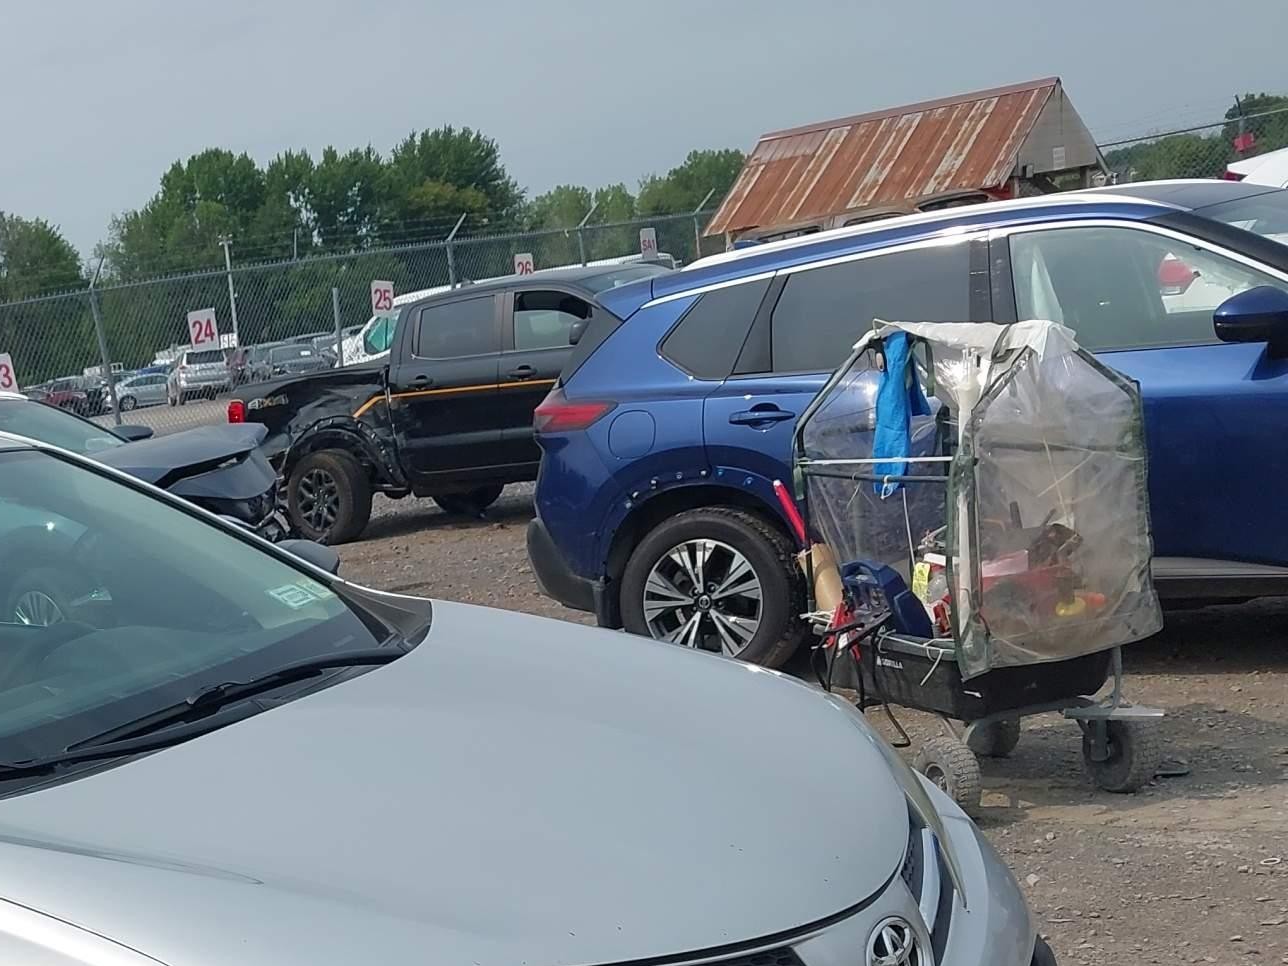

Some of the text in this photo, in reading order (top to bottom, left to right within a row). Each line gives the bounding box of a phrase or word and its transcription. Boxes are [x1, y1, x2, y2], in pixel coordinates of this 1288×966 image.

[517, 261, 532, 275] 26
[374, 288, 392, 311] 25
[192, 319, 215, 344] 24
